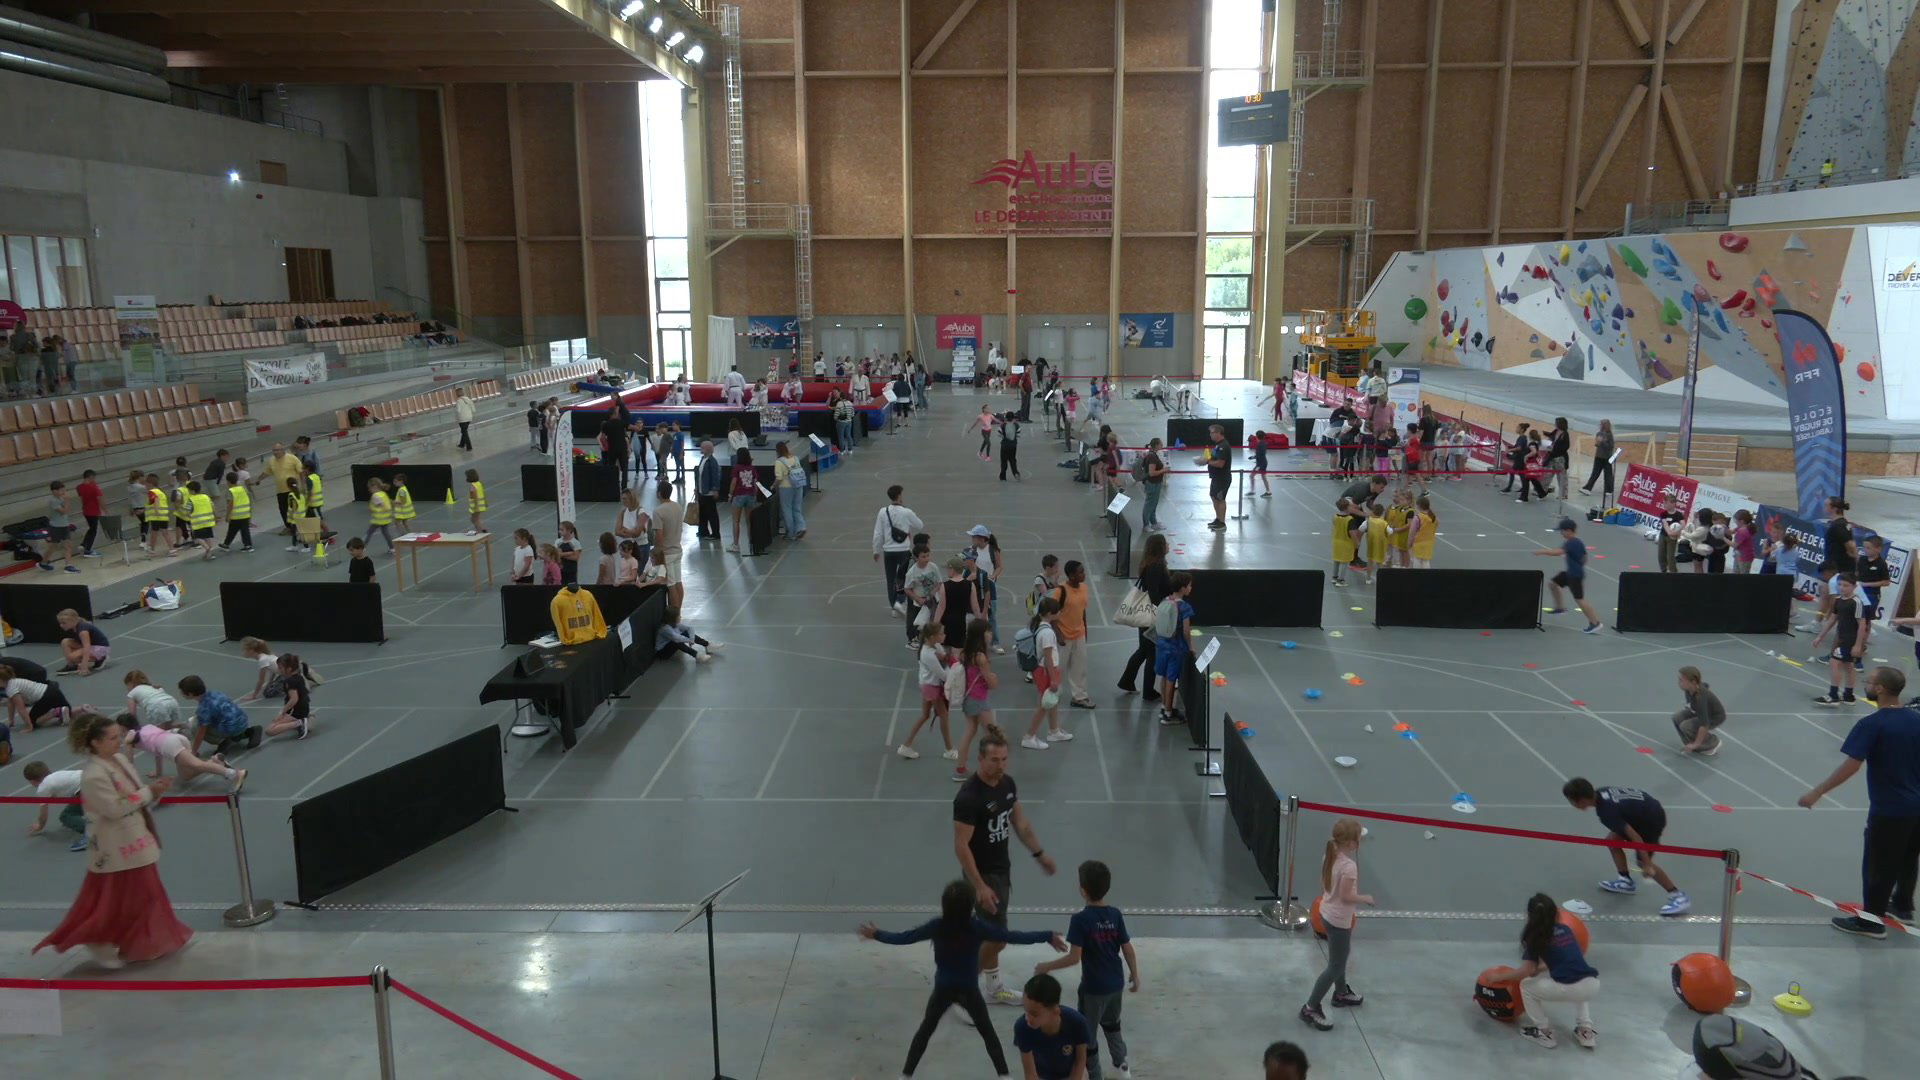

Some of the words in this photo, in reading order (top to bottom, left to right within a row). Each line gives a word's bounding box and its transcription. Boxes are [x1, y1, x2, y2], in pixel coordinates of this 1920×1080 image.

[1011, 149, 1115, 189] Aube
[974, 210, 991, 224] LE
[951, 322, 976, 332] Aube
[265, 372, 304, 387] CIRQUE
[1635, 472, 1657, 493] Aube
[1808, 534, 1819, 547] DE
[1120, 603, 1158, 617] RIMARK
